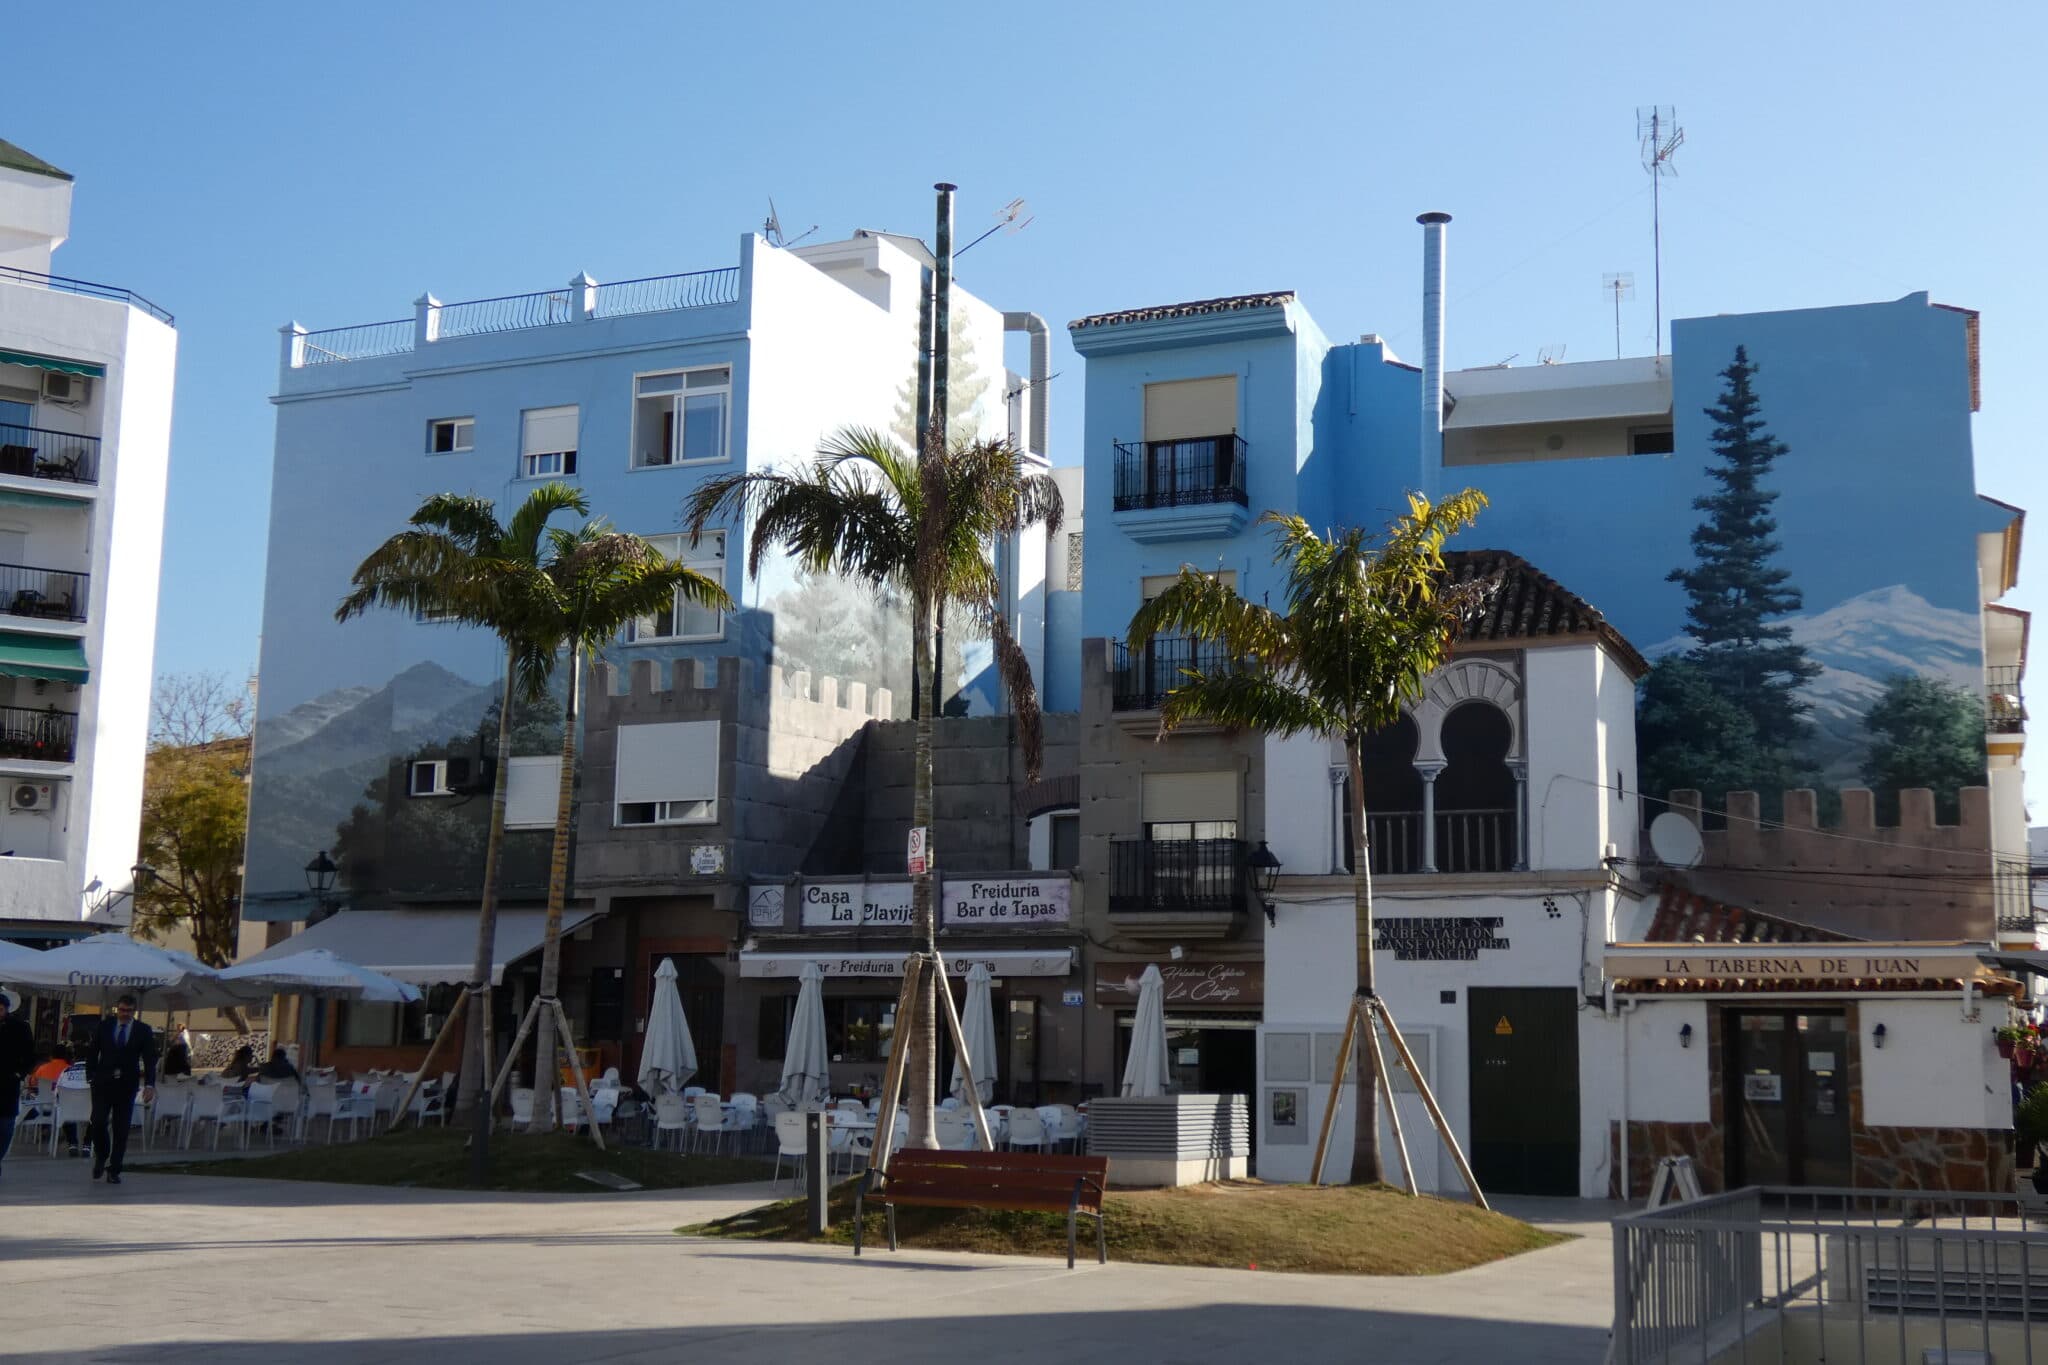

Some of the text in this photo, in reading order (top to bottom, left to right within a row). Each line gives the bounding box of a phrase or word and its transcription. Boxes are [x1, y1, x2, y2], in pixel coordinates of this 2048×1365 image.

[807, 886, 850, 904] Casa
[831, 904, 853, 921] La
[956, 900, 1056, 919] Bar de Tapas
[1472, 917, 1483, 929] S
[1494, 917, 1504, 929] A
[1379, 928, 1494, 939] SUBESTACION
[1374, 939, 1510, 950] RANSFORMADORA
[1395, 949, 1479, 961] CALANCHA
[1665, 959, 1920, 974] LA TABERNA DE JUAN
[1190, 980, 1240, 1001] Clavija
